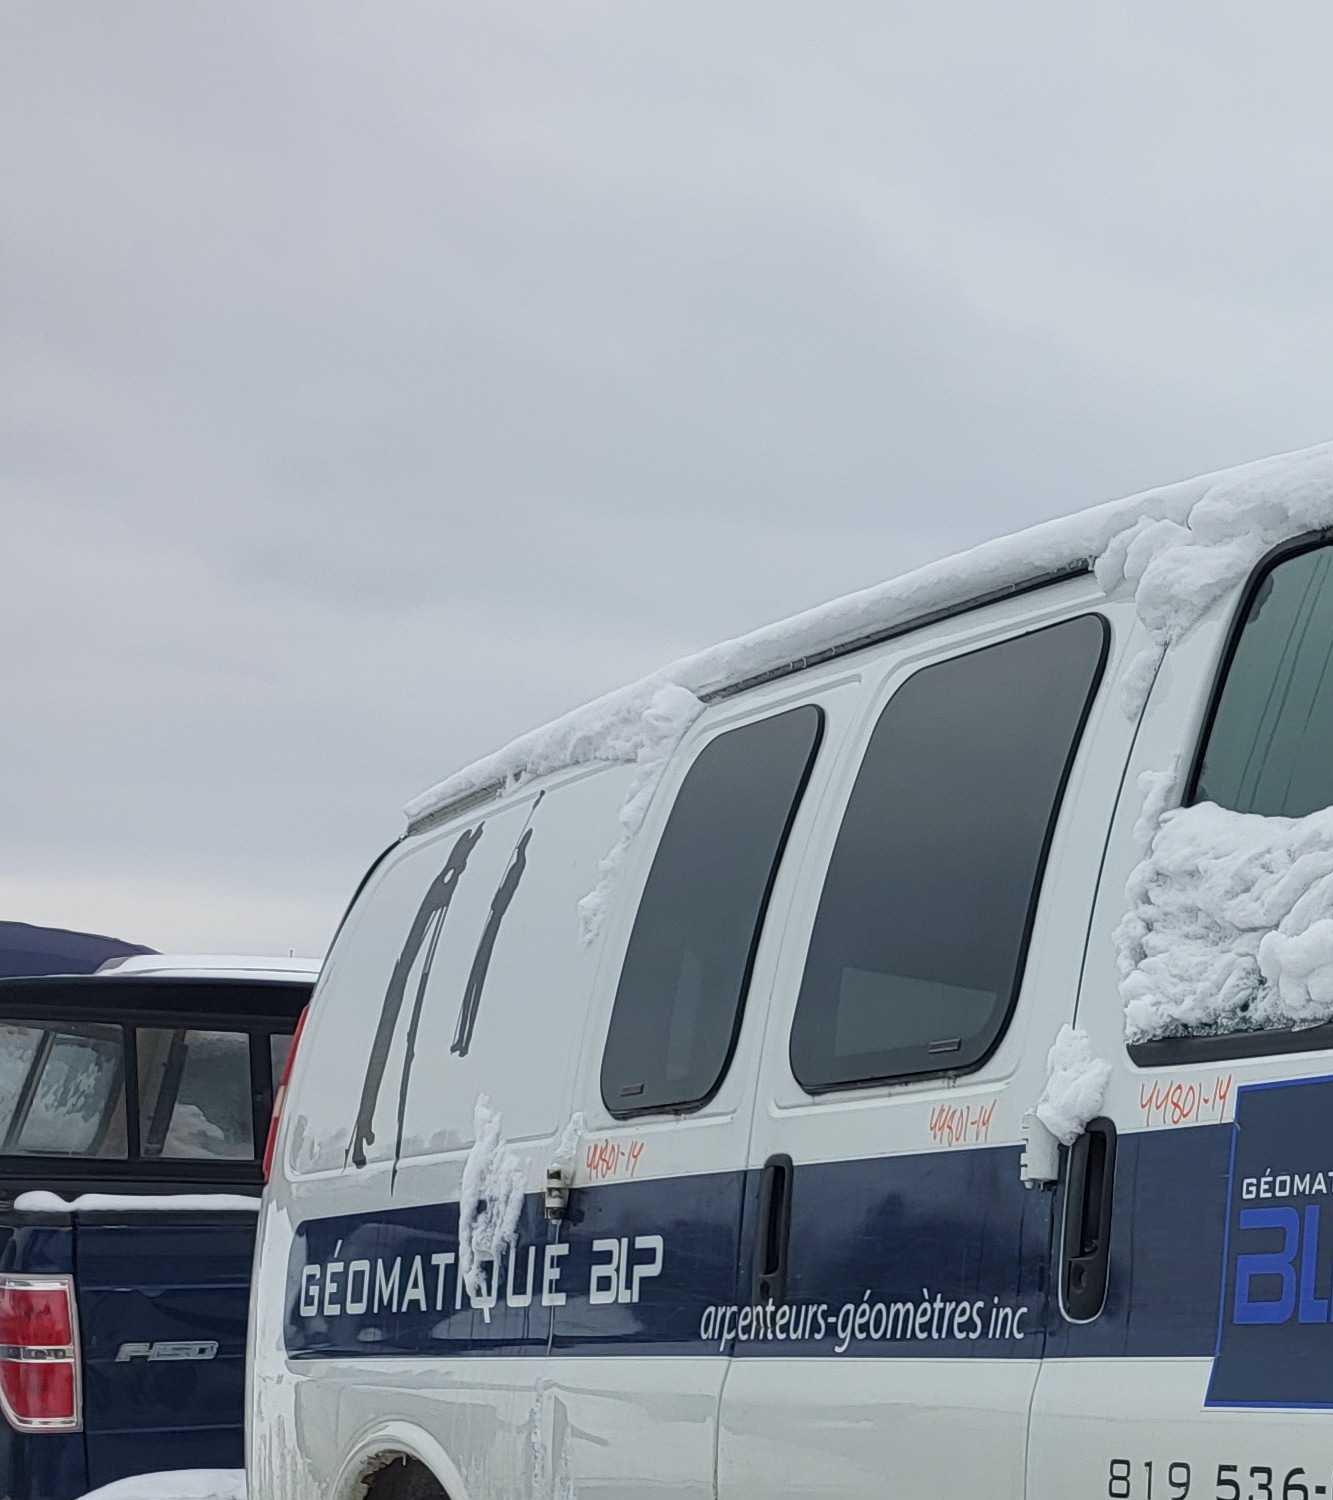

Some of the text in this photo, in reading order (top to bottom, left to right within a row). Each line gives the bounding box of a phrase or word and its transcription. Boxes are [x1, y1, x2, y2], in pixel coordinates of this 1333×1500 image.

[1139, 1074, 1232, 1126] 44801-14
[589, 1234, 664, 1305] BLP
[699, 1287, 1028, 1354] arpenteurs-géomètres inc
